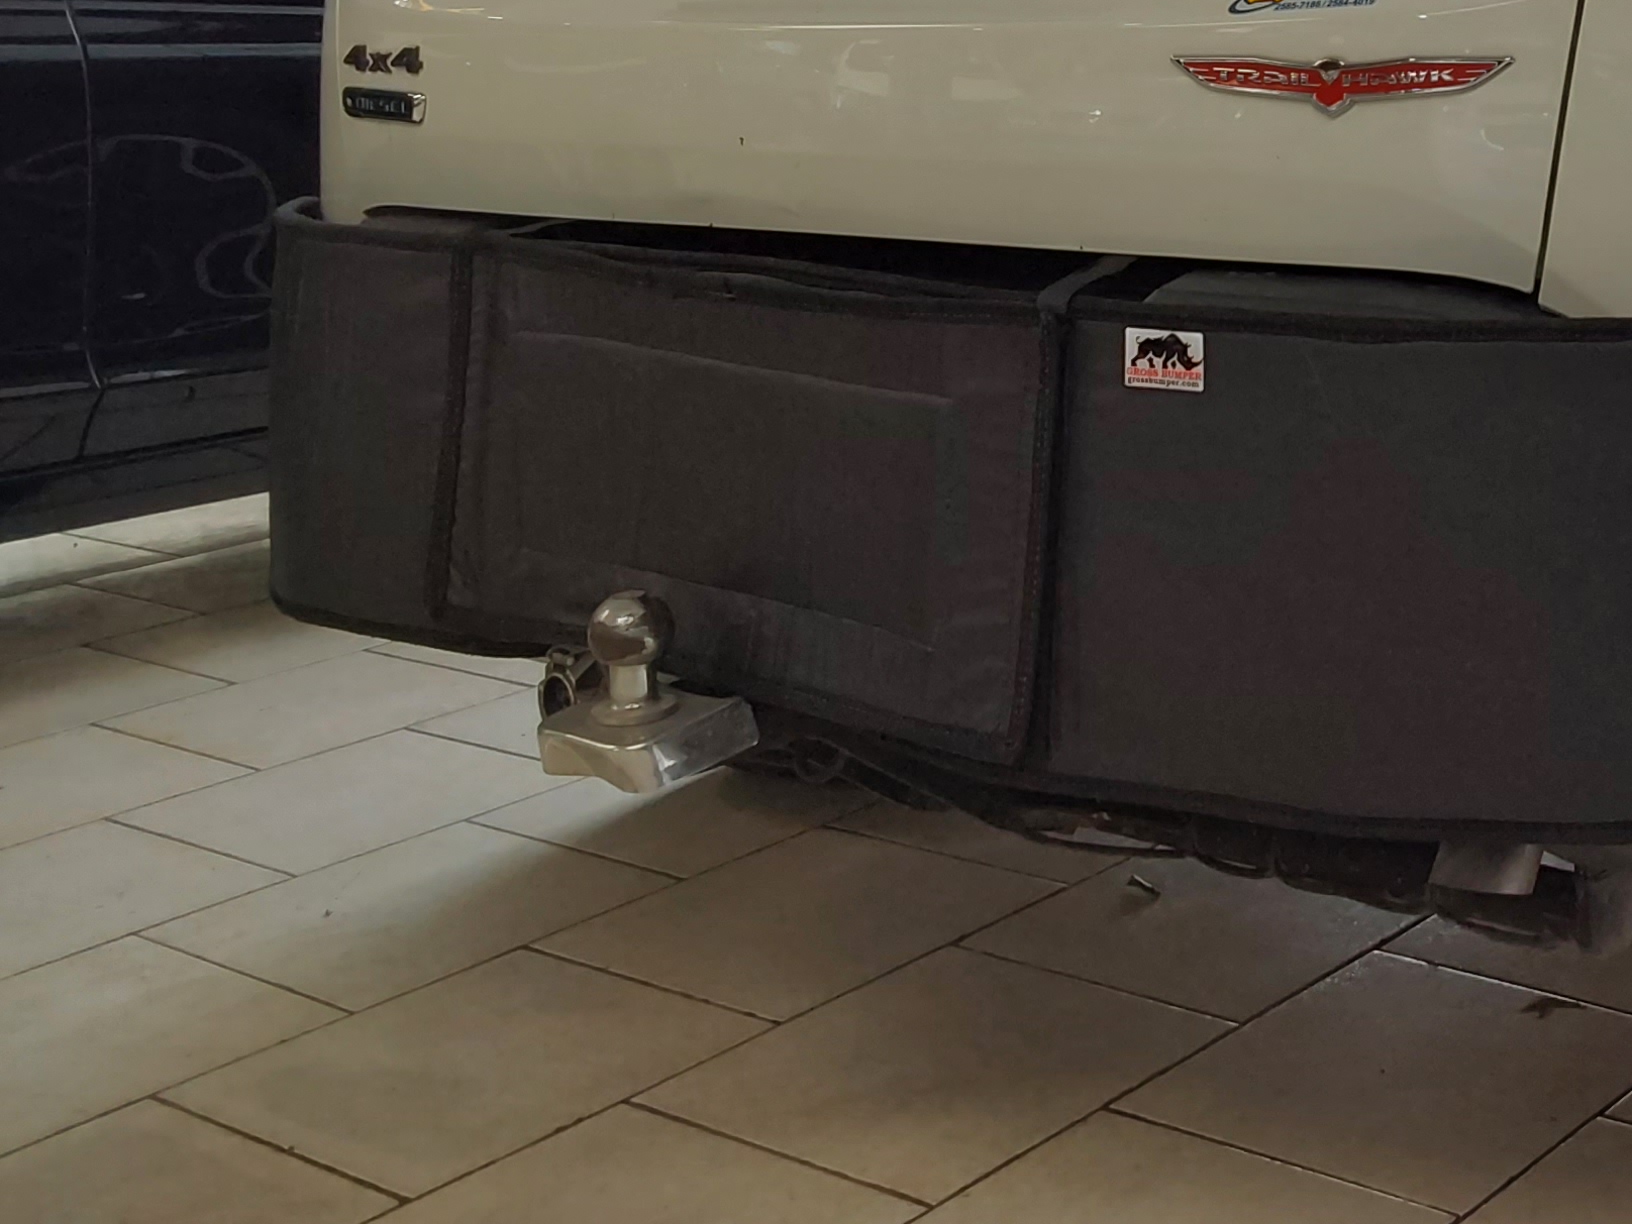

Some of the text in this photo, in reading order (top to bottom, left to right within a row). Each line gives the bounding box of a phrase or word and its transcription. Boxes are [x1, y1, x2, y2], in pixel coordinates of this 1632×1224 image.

[343, 44, 424, 75] 4x4
[1126, 366, 1159, 378] GROSS
[1128, 377, 1199, 388] grossbumper.com
